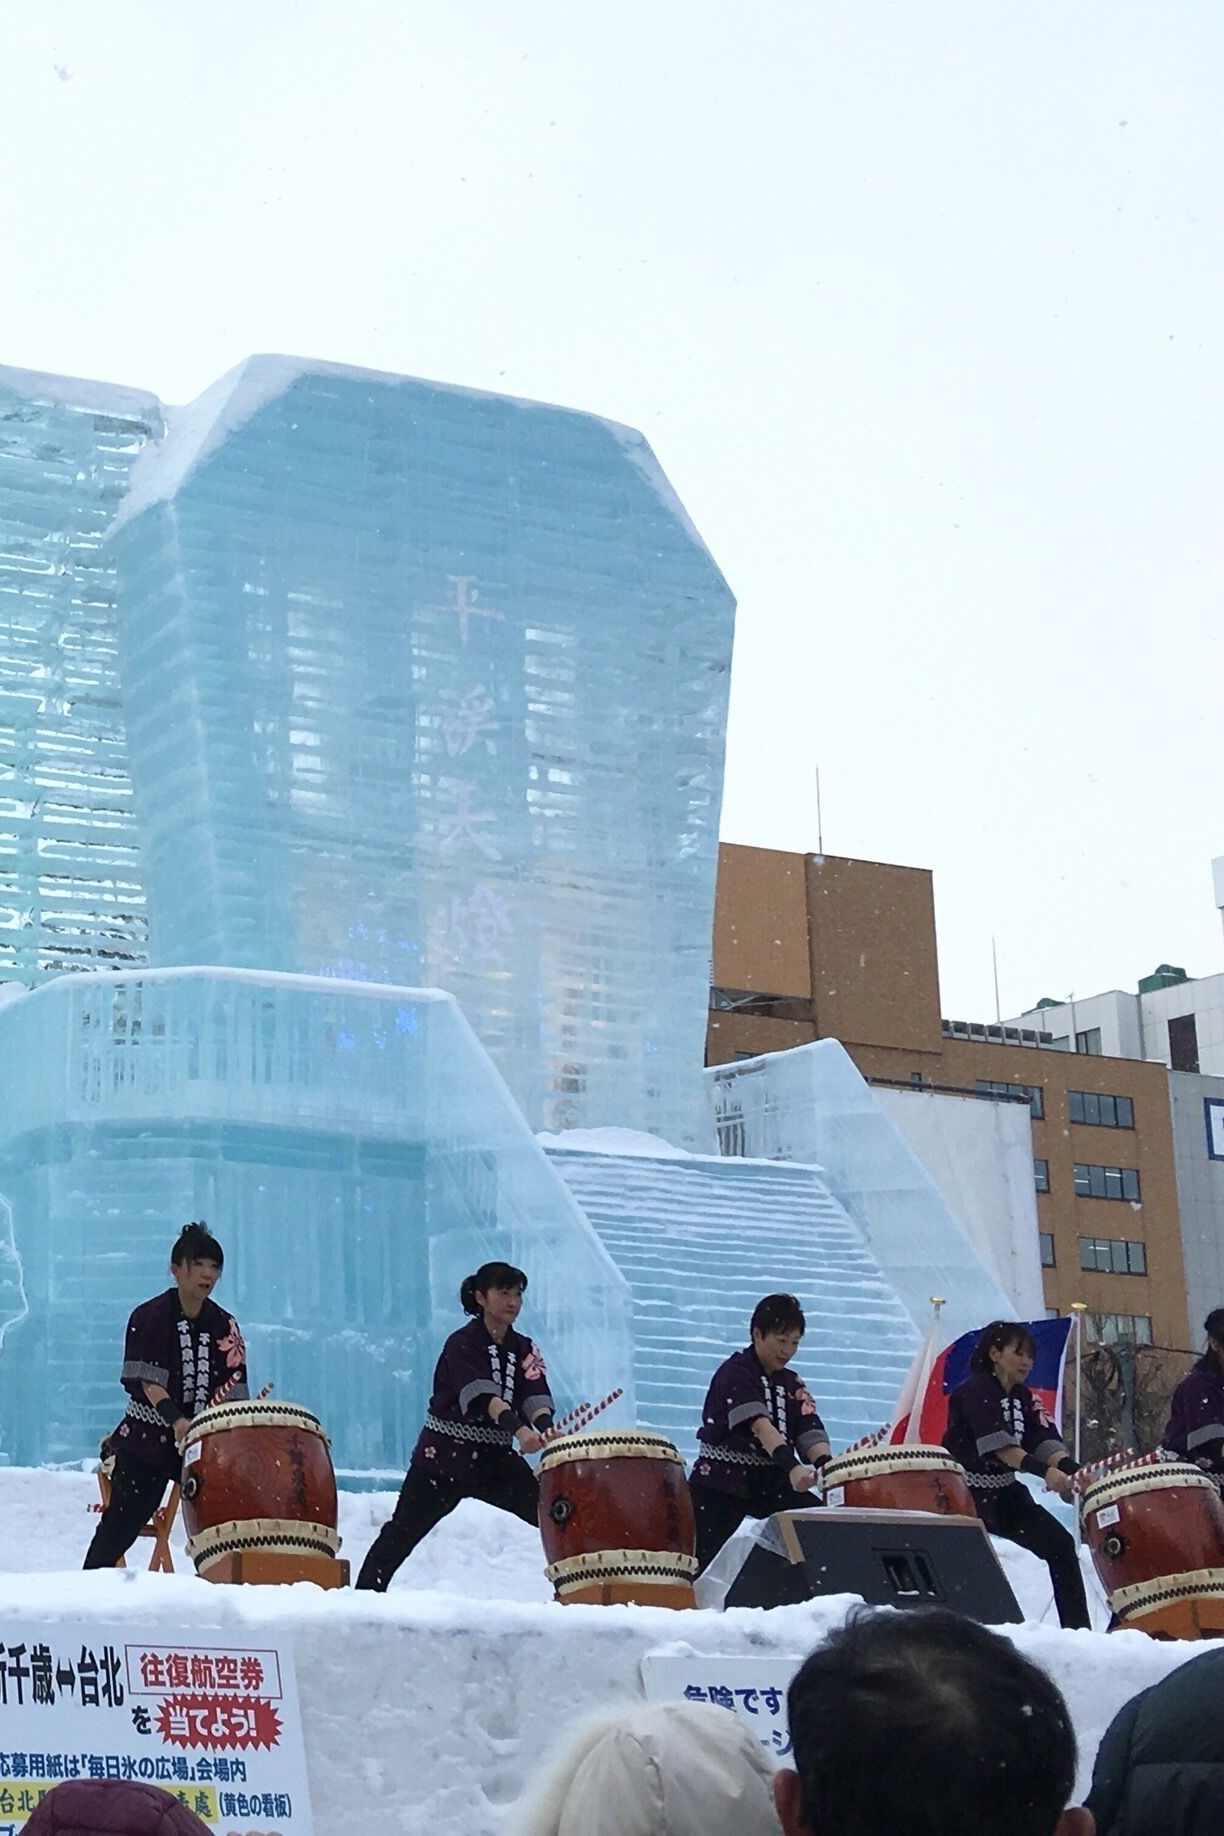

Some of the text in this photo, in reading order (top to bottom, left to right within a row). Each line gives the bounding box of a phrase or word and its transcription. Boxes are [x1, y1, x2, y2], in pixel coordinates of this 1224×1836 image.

[140, 1653, 264, 1690] 往復航空券
